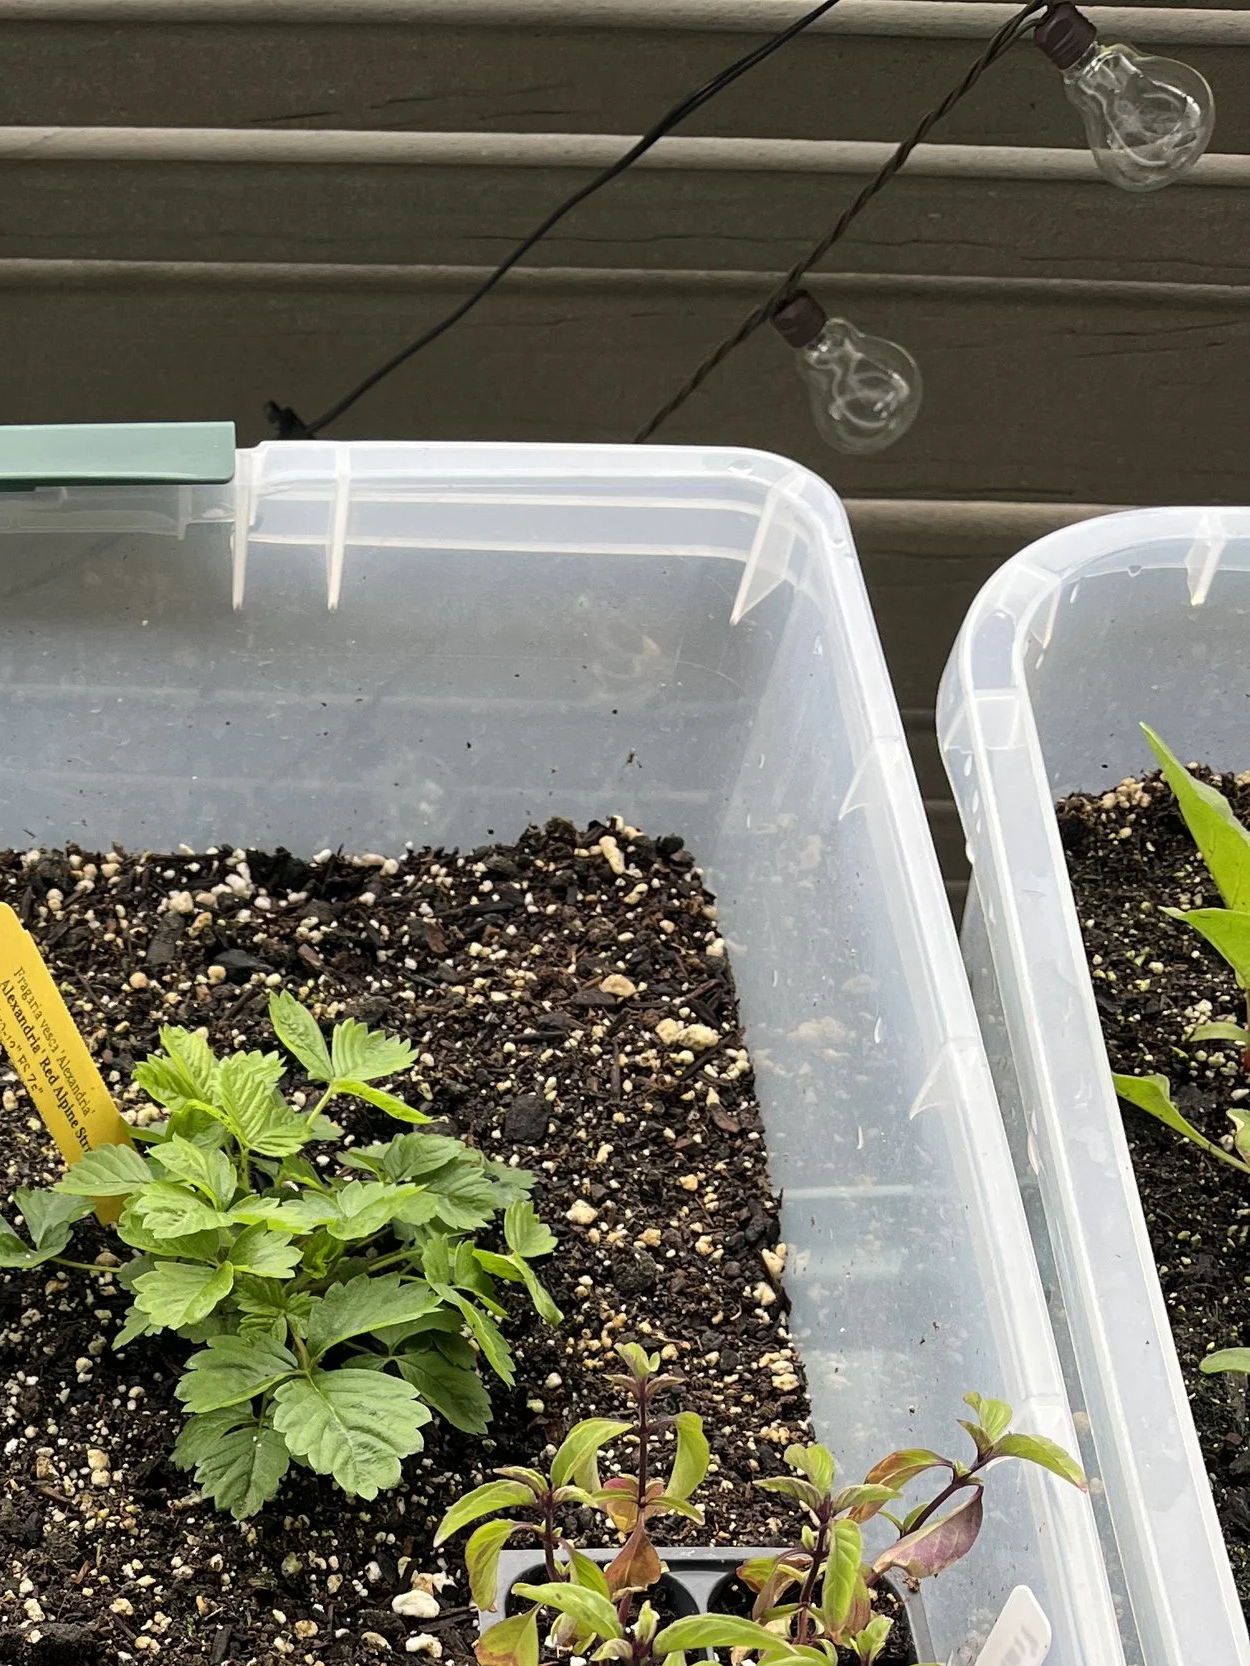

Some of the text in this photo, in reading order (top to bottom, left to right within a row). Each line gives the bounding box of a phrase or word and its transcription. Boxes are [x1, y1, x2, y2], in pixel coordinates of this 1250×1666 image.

[14, 966, 42, 1019] Fragaria
[39, 1055, 59, 1085] Red
[53, 1085, 79, 1129] Alpine
